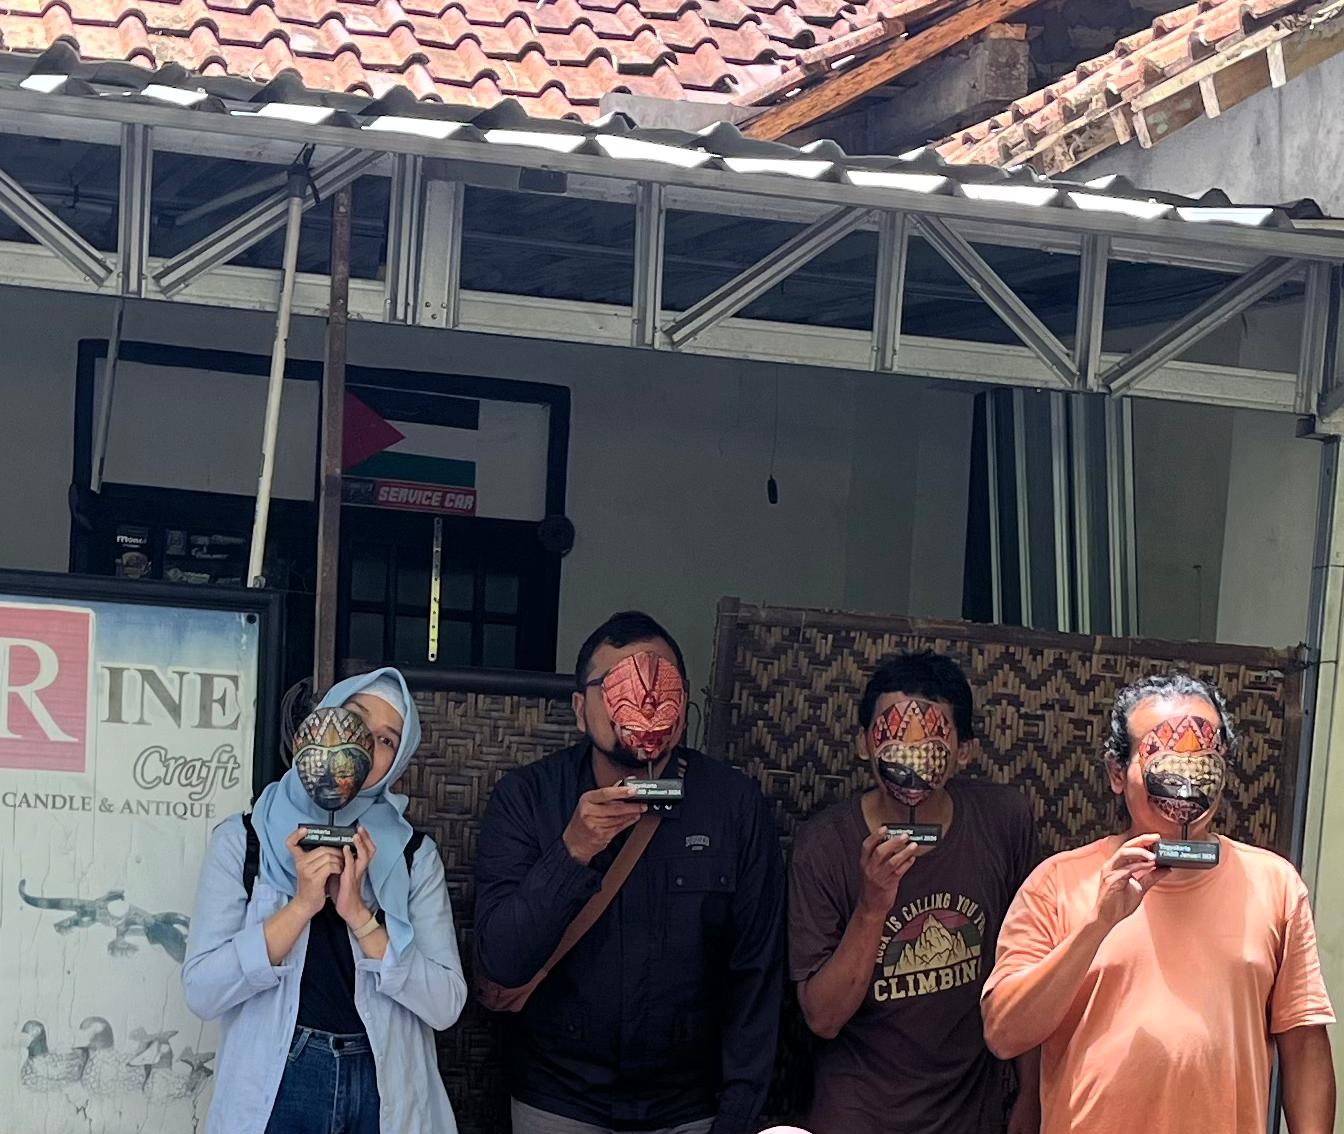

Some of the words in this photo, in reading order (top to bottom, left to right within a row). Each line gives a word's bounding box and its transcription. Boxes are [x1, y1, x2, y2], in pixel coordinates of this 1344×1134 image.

[378, 486, 442, 506] SERVICE
[444, 492, 474, 510] CAR
[133, 743, 240, 801] Craft
[2, 792, 92, 812] CANDLE
[98, 798, 114, 813] &
[120, 800, 216, 820] ANTIQUE
[886, 916, 902, 933] IS
[902, 892, 951, 921] CALLING
[957, 894, 979, 917] YOU
